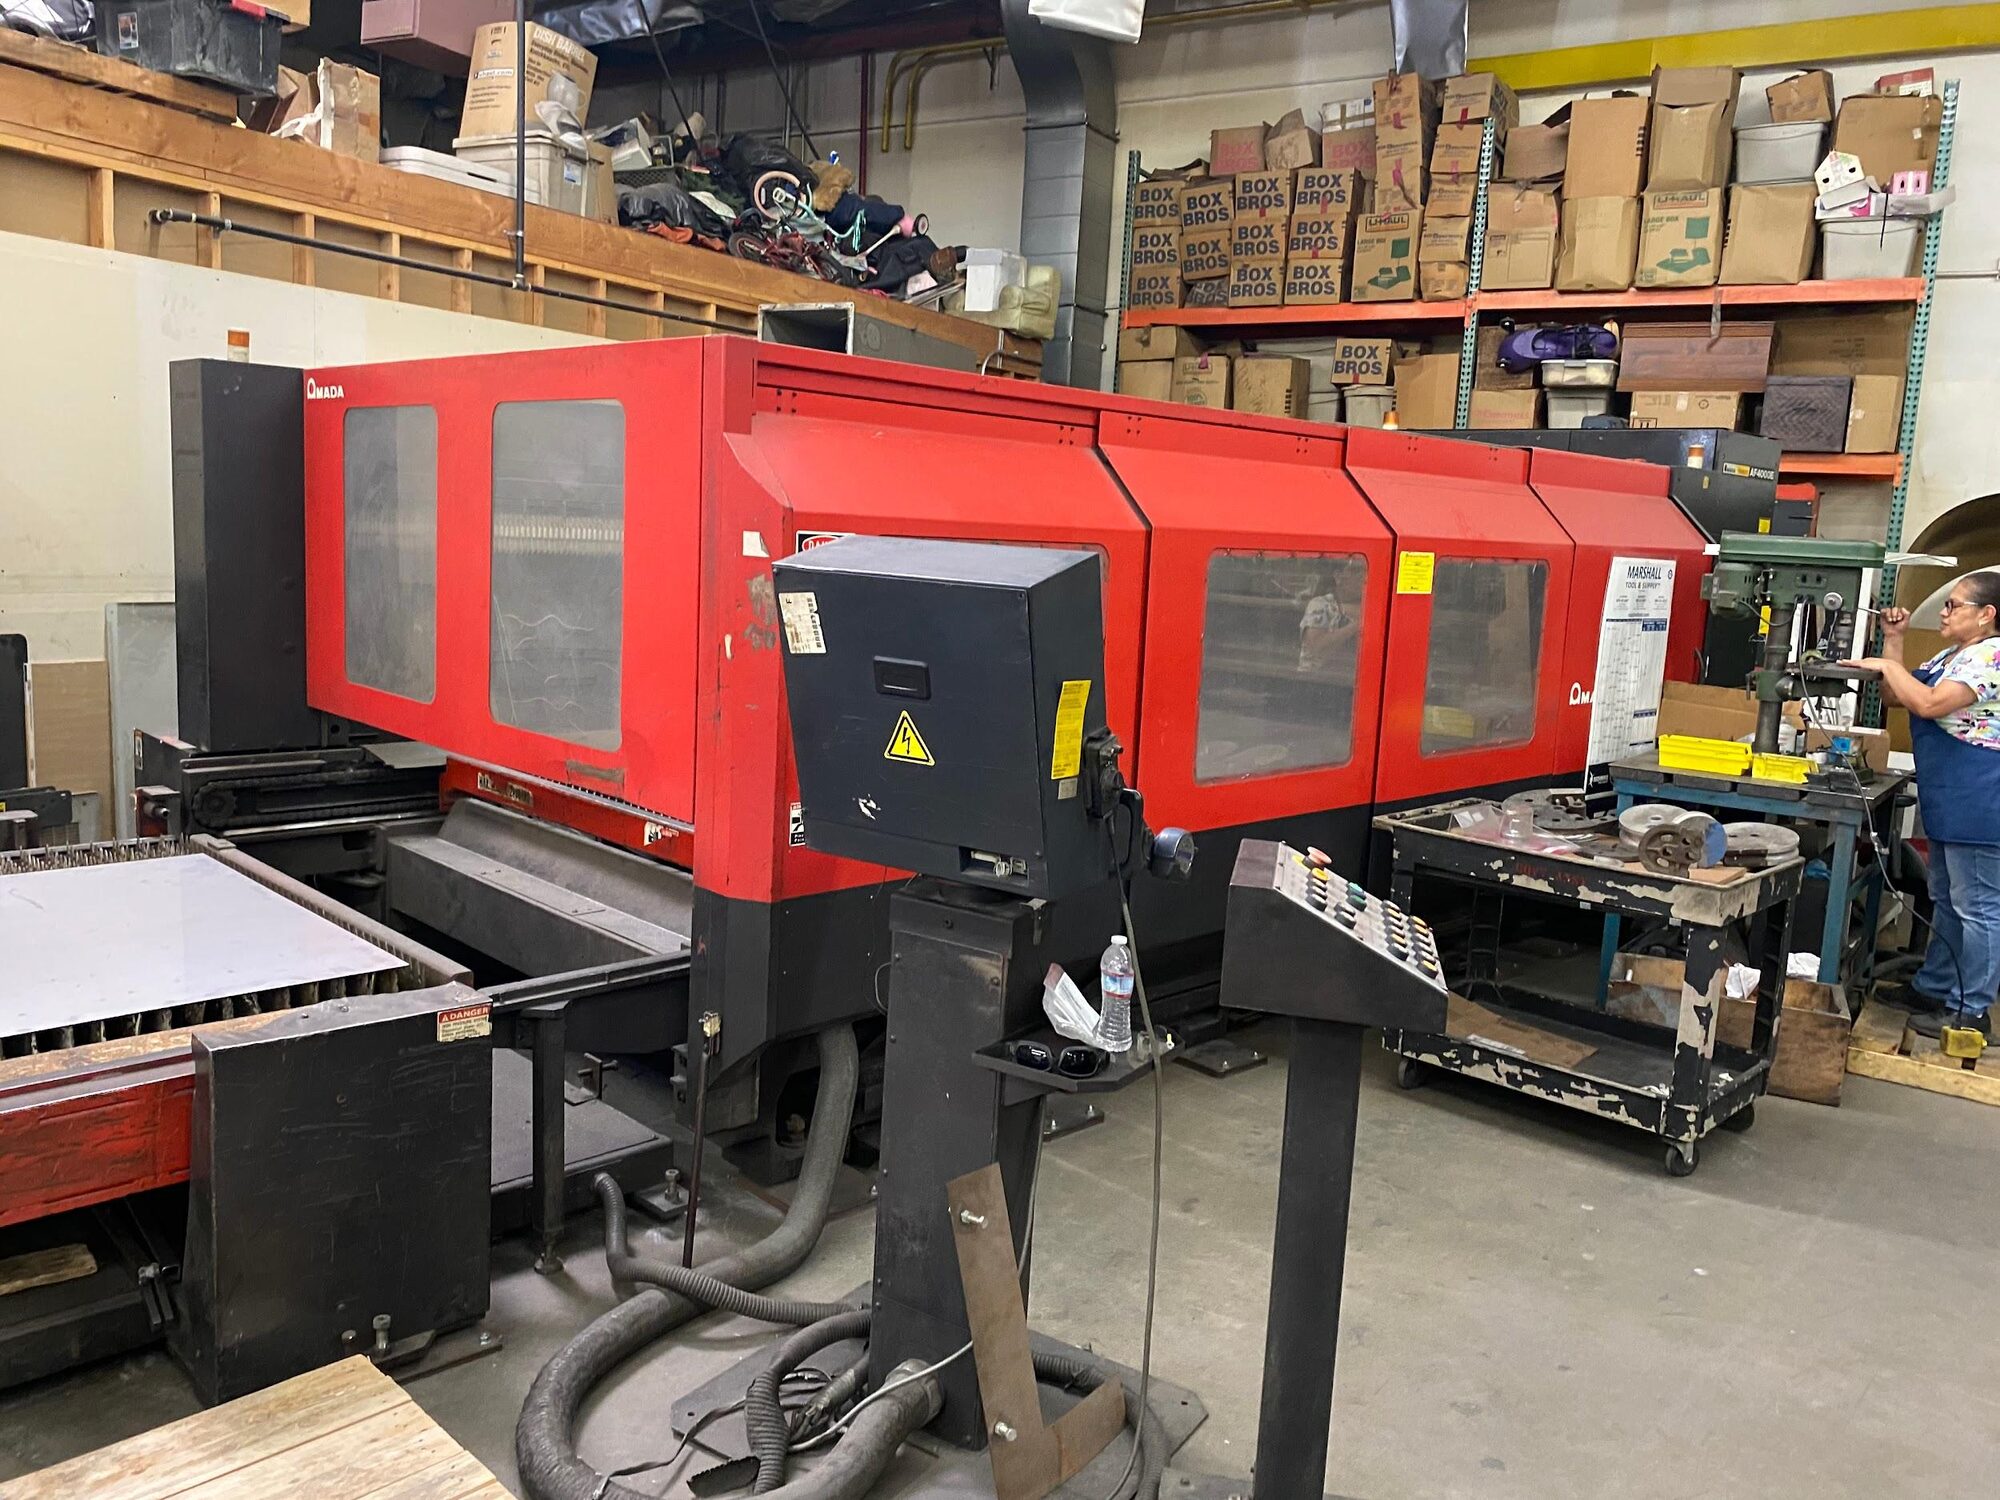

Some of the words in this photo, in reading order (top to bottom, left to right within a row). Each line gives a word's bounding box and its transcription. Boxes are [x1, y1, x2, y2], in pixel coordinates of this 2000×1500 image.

[533, 27, 558, 46] DISH
[1242, 177, 1279, 194] BOX
[1304, 174, 1343, 189] BOX
[1140, 188, 1174, 202] BOX
[1186, 191, 1223, 210] BOX
[1237, 193, 1284, 210] BROS
[1296, 189, 1346, 205] BROS
[1135, 203, 1179, 219] BROS
[1183, 207, 1230, 226] BROS
[1238, 224, 1274, 239] BOX
[1296, 220, 1335, 235] BOX
[1139, 233, 1172, 248] BOX
[1233, 240, 1280, 256] BROS
[1289, 236, 1338, 251] BROS
[1186, 240, 1221, 257] BOX
[1134, 249, 1177, 264] BROS
[1183, 254, 1229, 273] BROS
[1237, 266, 1273, 282] BOX
[1293, 264, 1331, 279] BOX
[1137, 276, 1170, 290] BOX
[1230, 282, 1277, 298] BROS
[1286, 281, 1335, 296] BROS
[1132, 291, 1174, 305] BROS
[1341, 345, 1379, 359] BOX
[1334, 361, 1382, 375] BROS
[1626, 566, 1662, 580] MARSHALL
[449, 1006, 489, 1021] DANGER
